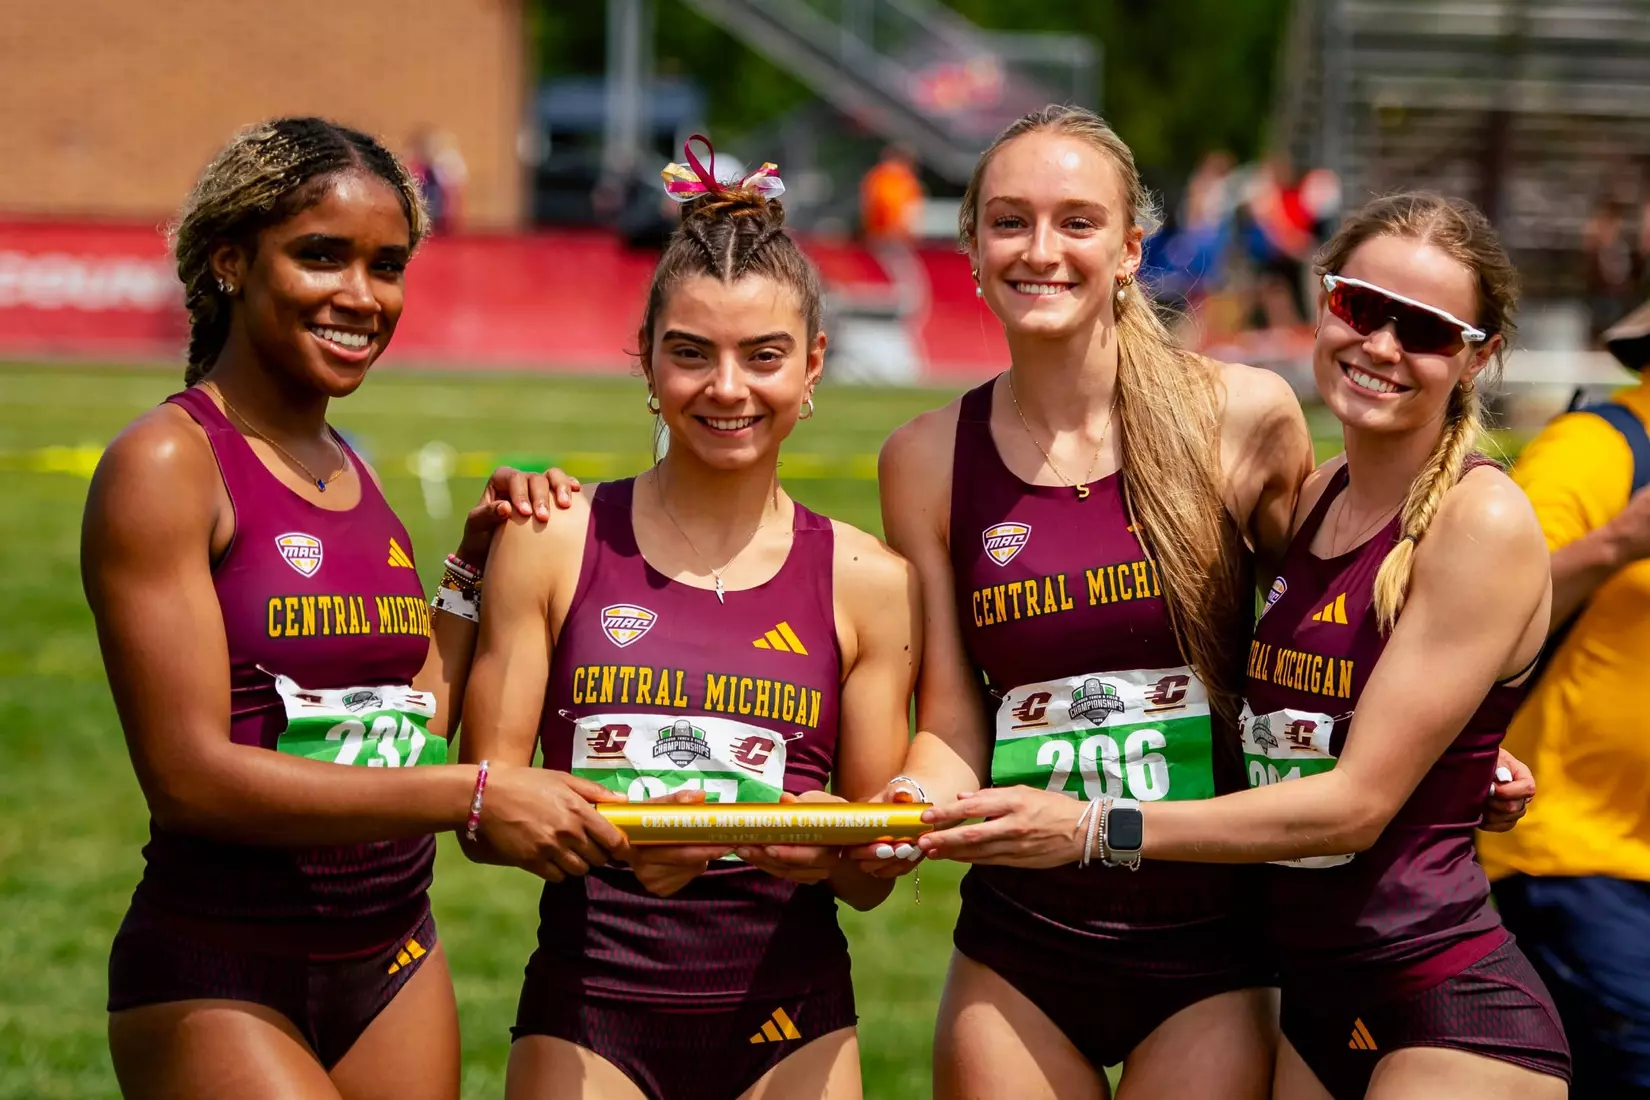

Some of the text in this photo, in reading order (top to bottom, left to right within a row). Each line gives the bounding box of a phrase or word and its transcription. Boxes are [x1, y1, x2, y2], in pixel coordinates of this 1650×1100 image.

[283, 546, 321, 558] MAC
[986, 535, 1025, 549] MAC
[973, 560, 1161, 628] CENTRAL MICHI
[268, 596, 431, 638] CENTRAL MICHIG
[604, 617, 650, 629] MAC
[1273, 648, 1354, 699] MICHIGAN
[573, 665, 823, 729] CENTRAL MICHIGAN
[1070, 698, 1124, 719] CHAMPIONSHIPS
[653, 740, 710, 758] CHAMPIONSHIPS
[1037, 729, 1170, 802] 206
[641, 814, 889, 828] CENTRAL MICHIGAN UNIVERSITY
